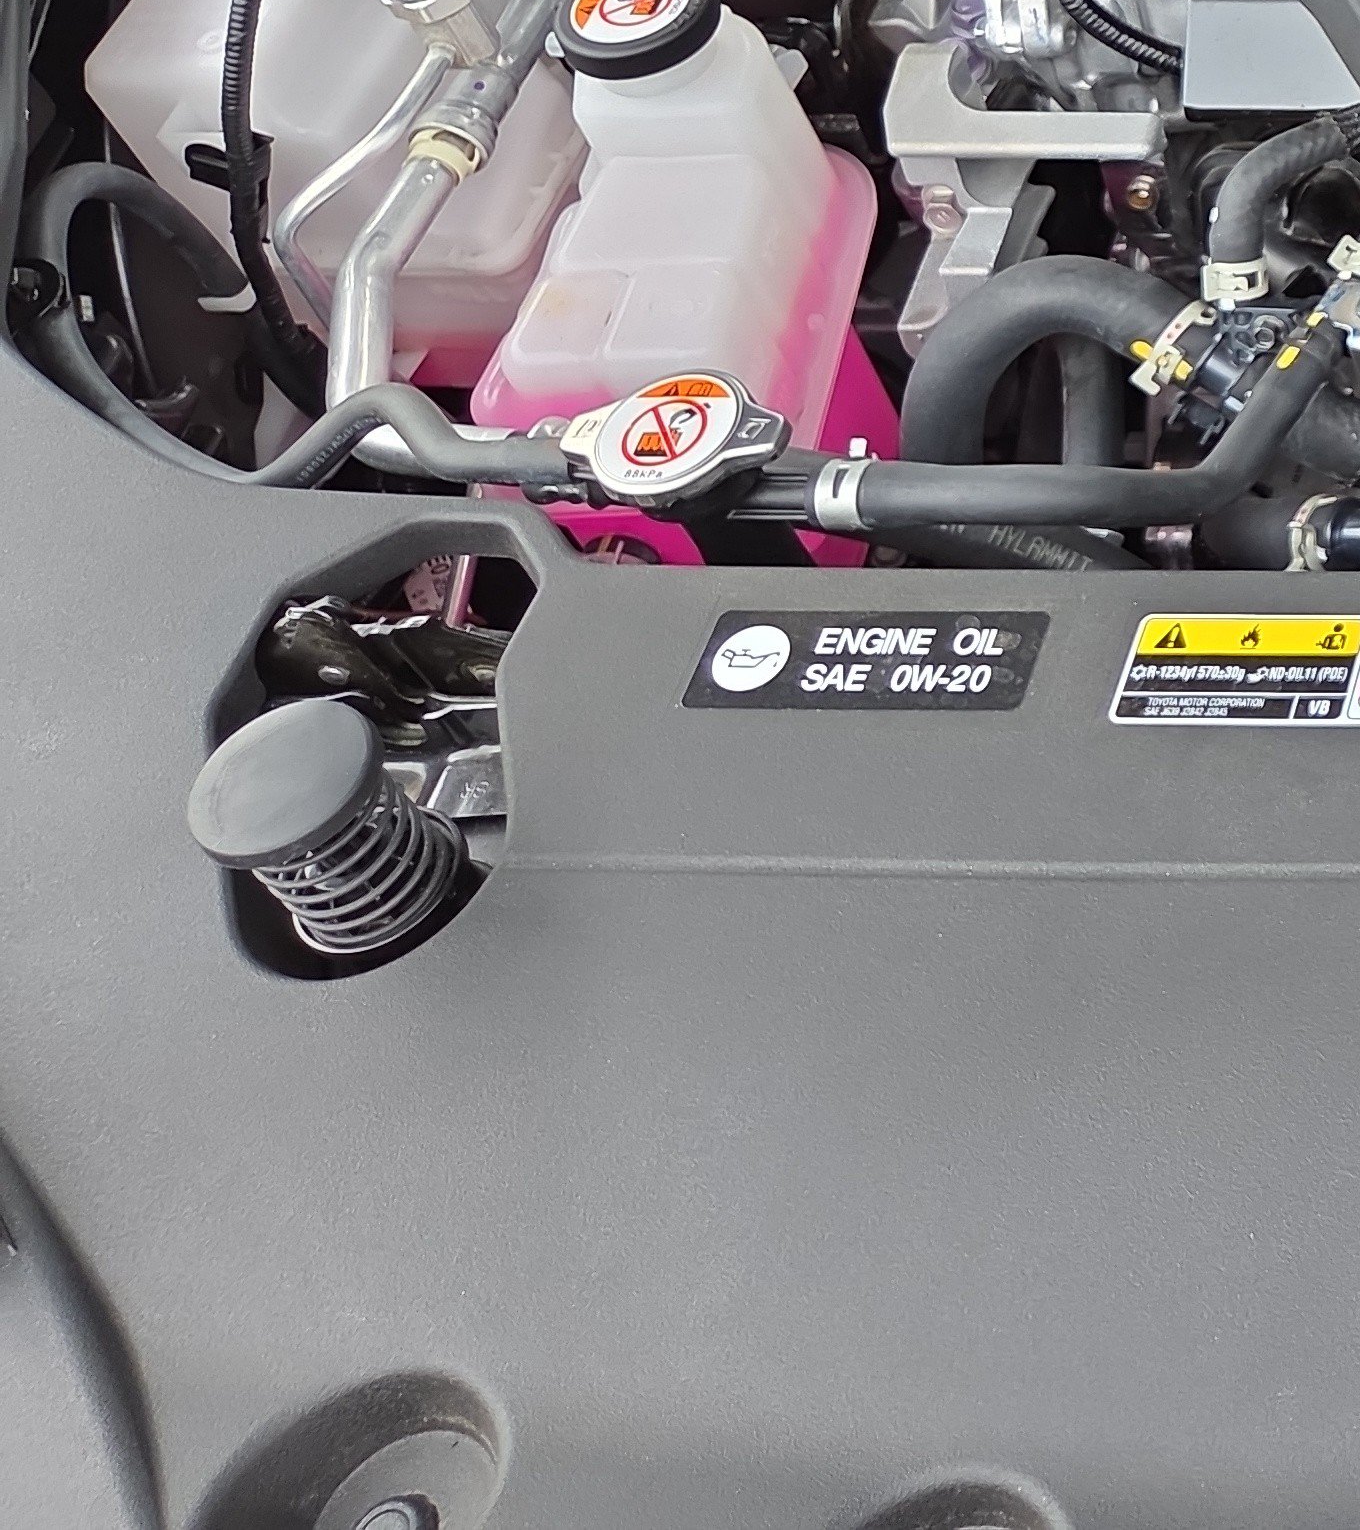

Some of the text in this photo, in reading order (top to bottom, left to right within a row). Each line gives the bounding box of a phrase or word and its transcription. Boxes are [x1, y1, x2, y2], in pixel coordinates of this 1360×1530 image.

[813, 627, 1004, 656] ENGINE OIL
[800, 663, 992, 692] SAE 0W-20
[1148, 696, 1265, 708] TOYOTA MOTOR CORPORATION
[1307, 700, 1330, 716] VB
